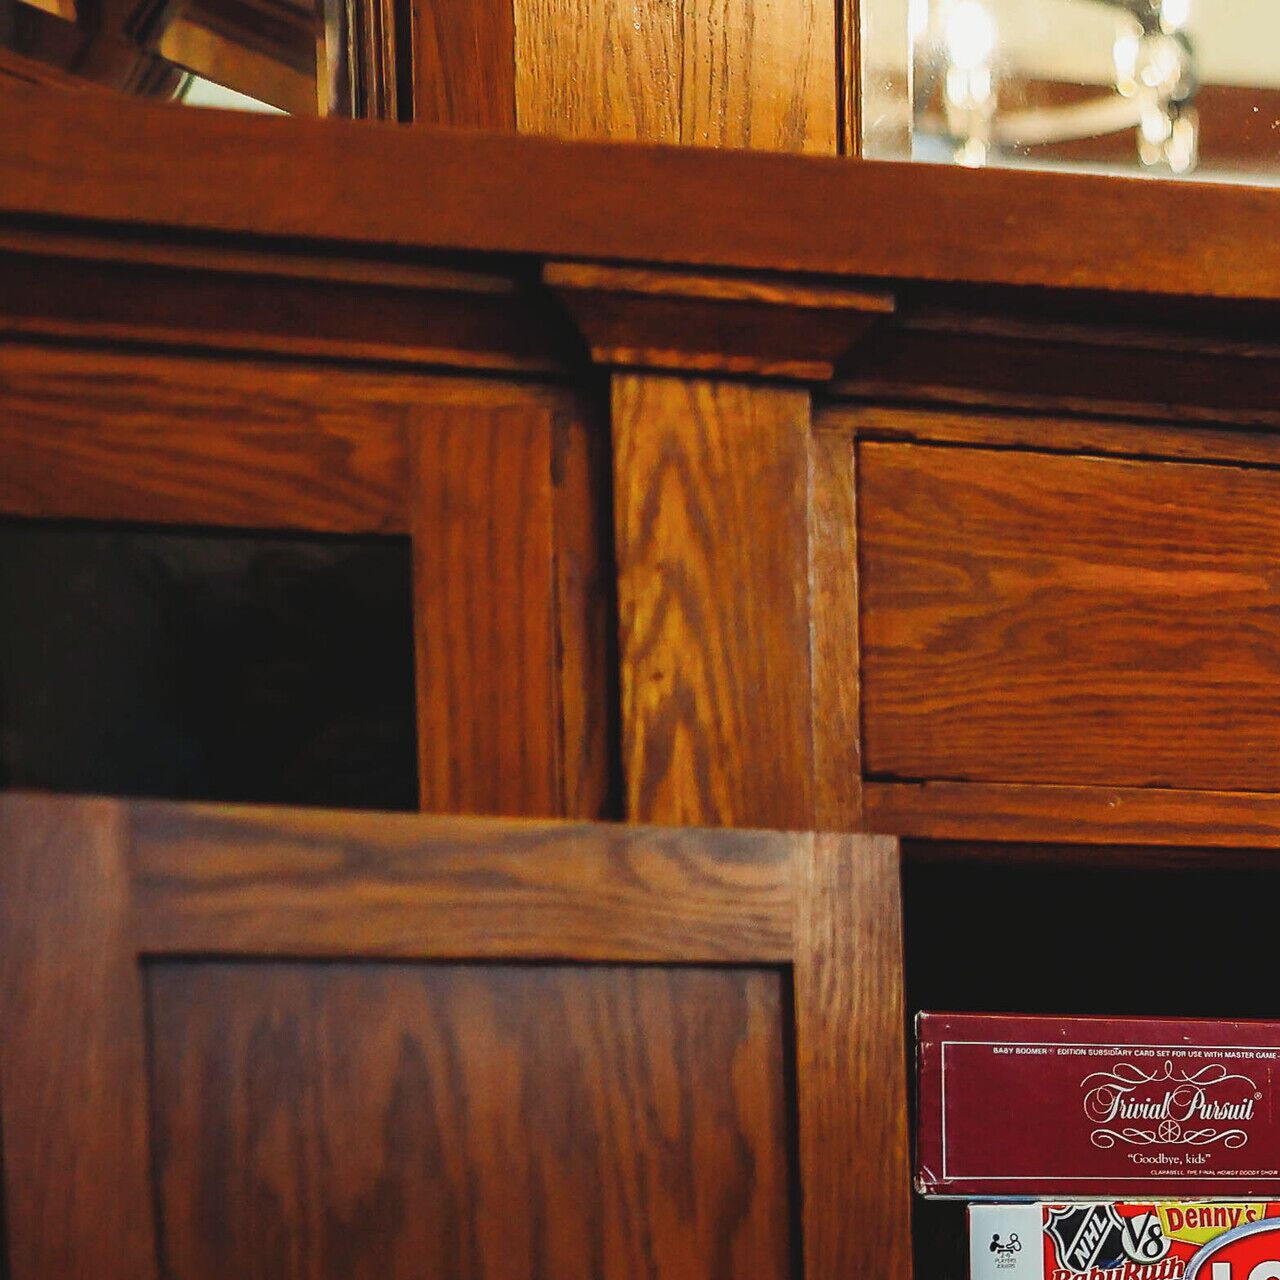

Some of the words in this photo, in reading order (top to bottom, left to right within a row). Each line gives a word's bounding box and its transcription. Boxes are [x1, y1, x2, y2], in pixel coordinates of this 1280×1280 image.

[993, 1047, 1013, 1055] BABY
[1016, 1047, 1047, 1055] BOOMER
[1057, 1048, 1086, 1056] EDITION
[1088, 1048, 1132, 1056] SUBSIDIARY
[1134, 1049, 1154, 1057] CARD
[1224, 1051, 1254, 1059] MASTER
[1084, 1084, 1171, 1124] Trivial
[1167, 1084, 1254, 1122] Pursuit
[1122, 1211, 1164, 1258] V8
[1166, 1203, 1257, 1232] Denny's
[1074, 1213, 1108, 1268] NHL
